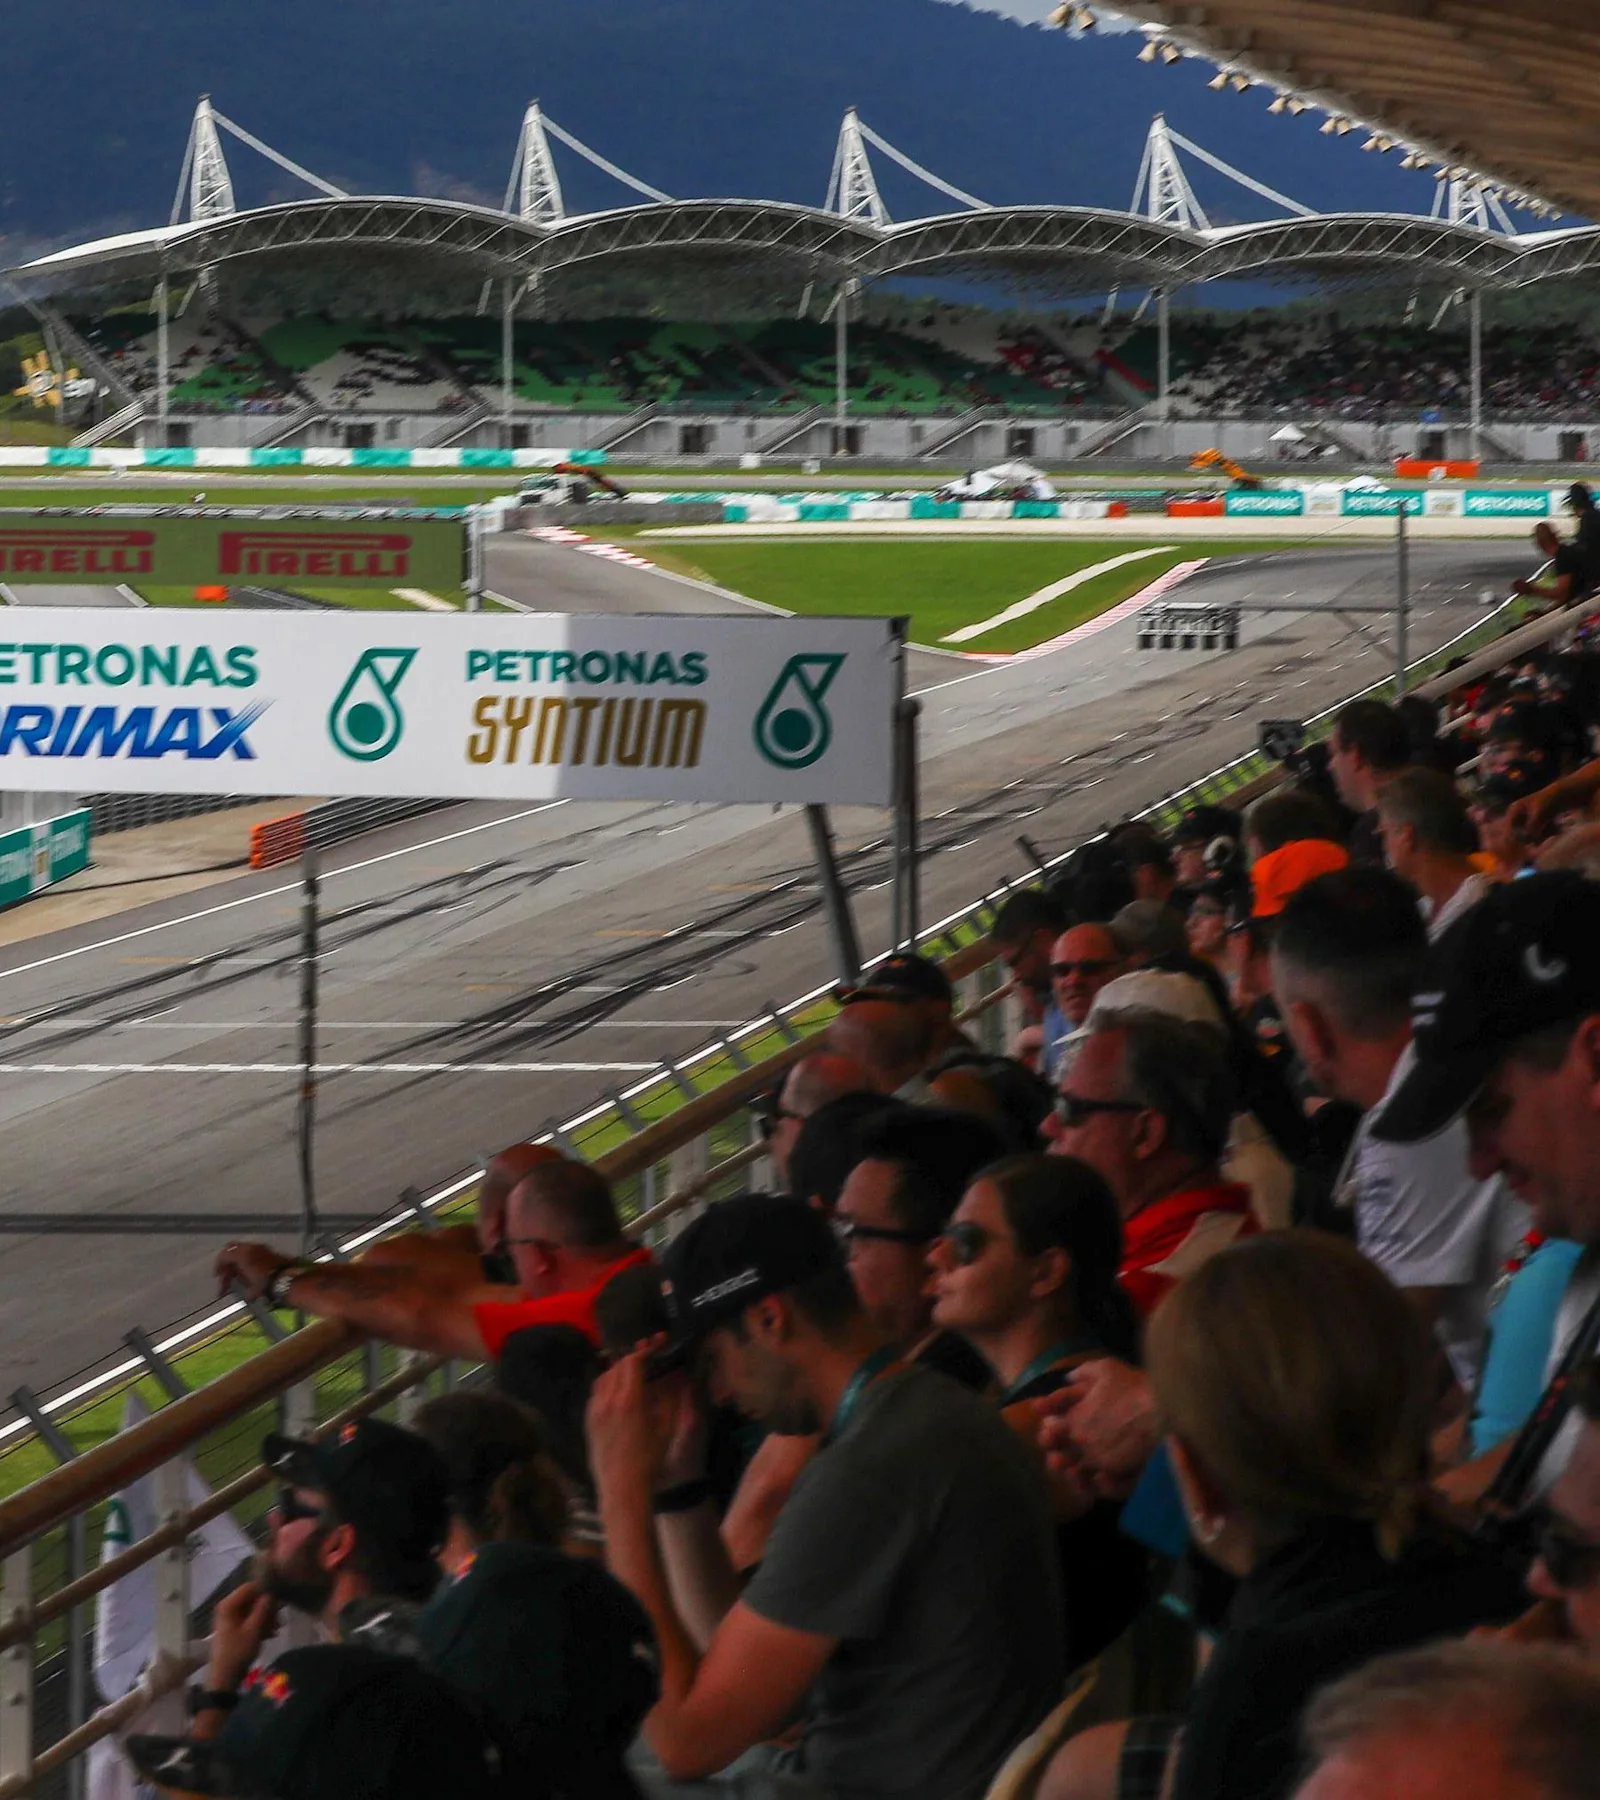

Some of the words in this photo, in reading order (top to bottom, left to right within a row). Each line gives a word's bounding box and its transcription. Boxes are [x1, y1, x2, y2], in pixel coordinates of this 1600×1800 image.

[218, 531, 413, 578] PIRELLI
[465, 649, 708, 686] PETRONAS
[466, 695, 708, 770] SYNTIUM
